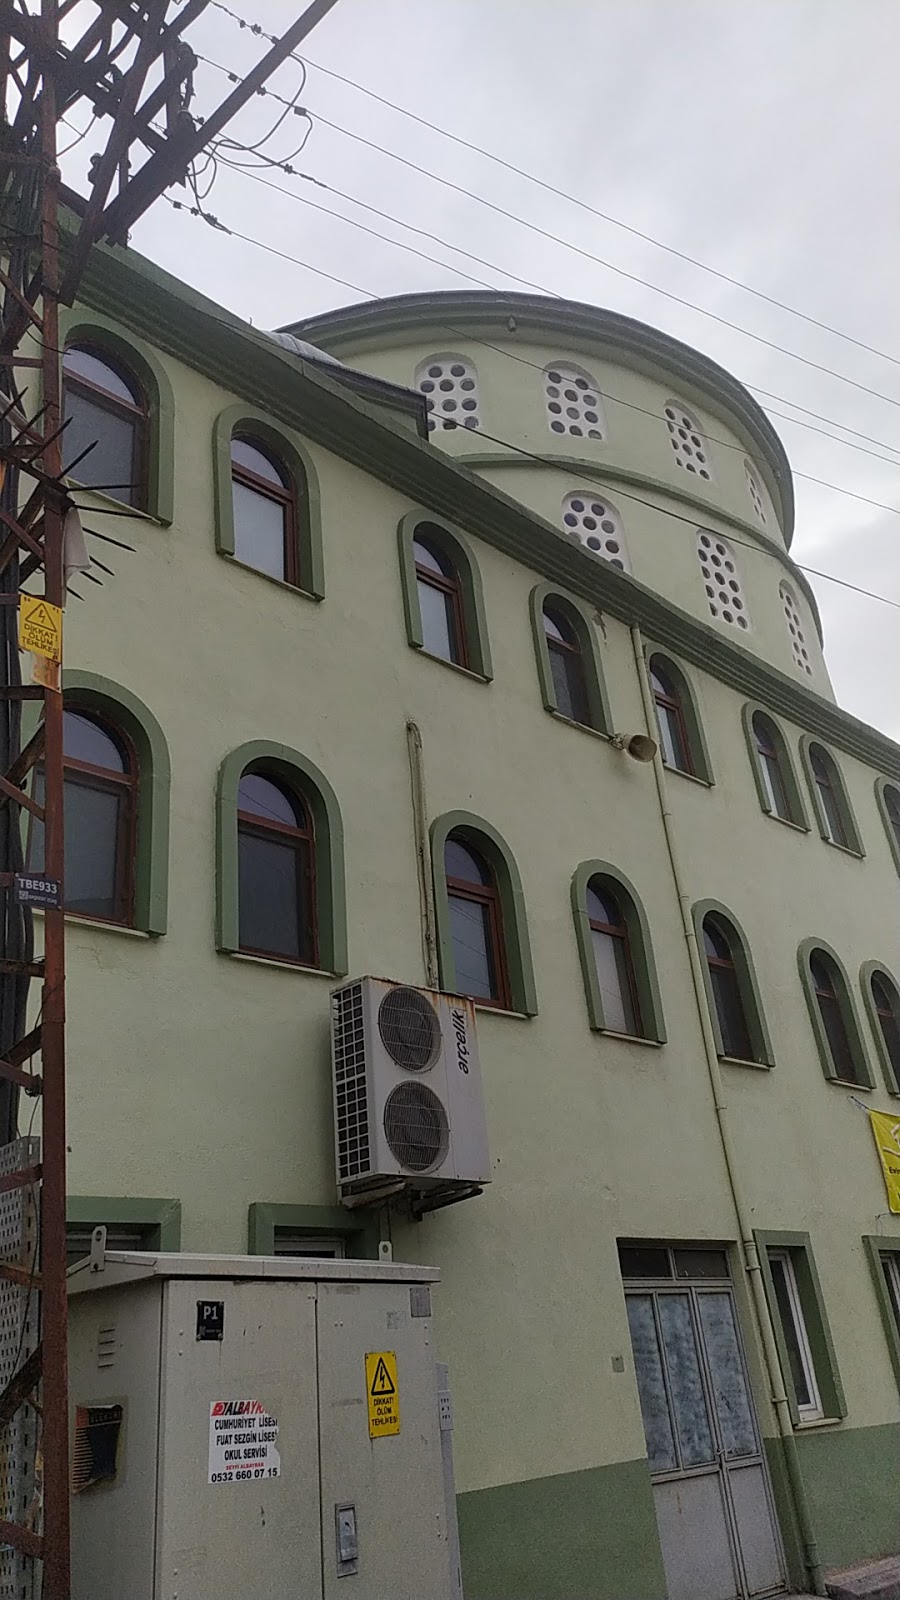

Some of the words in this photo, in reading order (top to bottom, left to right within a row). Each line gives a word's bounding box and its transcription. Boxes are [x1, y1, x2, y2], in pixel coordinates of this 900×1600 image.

[28, 632, 53, 646] ÖLÜM
[17, 878, 58, 894] TBE933
[451, 1010, 469, 1075] arçelik
[203, 1306, 219, 1318] P1
[377, 1406, 392, 1415] ÖLÜM
[215, 1416, 256, 1430] CUMHURİYET
[216, 1434, 233, 1446] FUAT
[234, 1430, 257, 1445] SEZGİN
[224, 1449, 242, 1461] OKUL
[243, 1444, 268, 1460] SERVİSİ
[211, 1472, 233, 1483] 0532
[236, 1469, 252, 1480] 660
[254, 1468, 265, 1478] 07
[267, 1467, 278, 1476] 15
